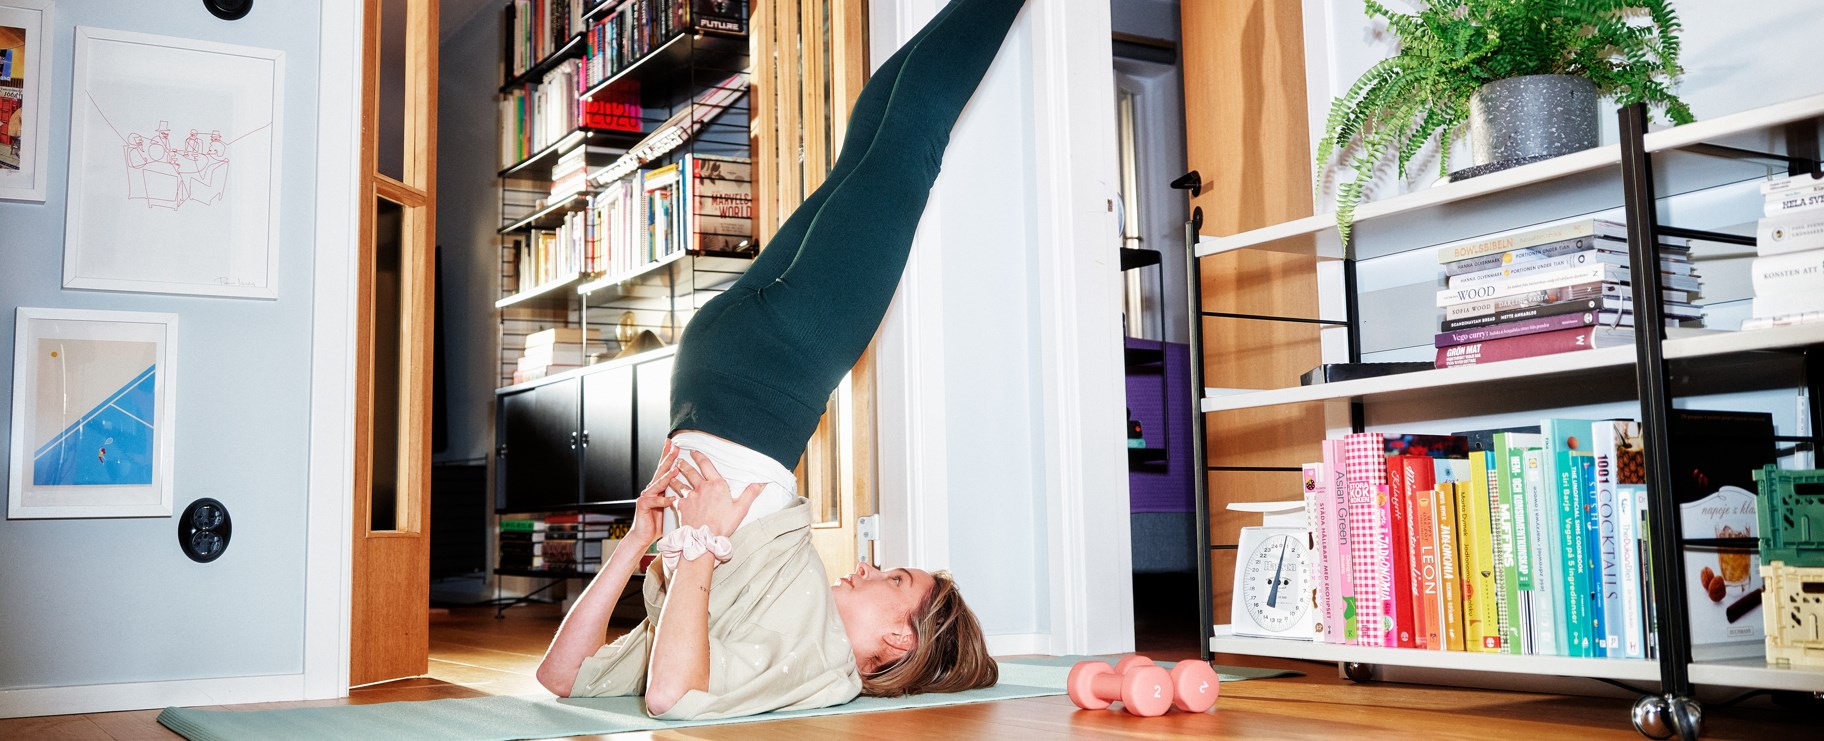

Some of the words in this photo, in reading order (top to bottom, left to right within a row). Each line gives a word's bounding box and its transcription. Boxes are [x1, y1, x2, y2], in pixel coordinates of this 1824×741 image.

[700, 19, 739, 30] FUTURE
[711, 193, 749, 206] MARVELS
[1782, 198, 1807, 210] HELA
[719, 205, 752, 219] WORLD
[1454, 238, 1513, 257] BOWLSBIBELN
[1457, 262, 1473, 270] HANNA
[1516, 250, 1541, 259] PORTIONEN
[1511, 266, 1536, 274] PORTIONEN
[1538, 262, 1552, 270] UNDER
[1764, 269, 1800, 279] KONSTEN
[1803, 266, 1817, 274] ATT
[1457, 285, 1496, 301] WOOD
[1452, 307, 1470, 315] SOFIA
[1472, 303, 1491, 312] WOOD
[1451, 319, 1481, 328] SCANDINAVIAN
[1452, 333, 1468, 343] Vego
[1447, 345, 1465, 358] GRÖN
[1466, 344, 1482, 354] MAT
[1598, 454, 1610, 484] 1001
[1335, 471, 1347, 505] Asian
[1405, 466, 1416, 497] Min
[1350, 489, 1369, 498] KOK
[1589, 481, 1598, 529] SUSHI
[1701, 502, 1730, 519] napoje
[1338, 508, 1348, 546] Green
[1499, 503, 1514, 568] MUFFINS
[1564, 517, 1573, 546] Vegan
[1566, 547, 1575, 559] på
[1600, 489, 1618, 600] COCKTAILS
[1464, 544, 1472, 583] Jadłonomia
[1536, 547, 1544, 577] zdrowiej
[1576, 536, 1584, 574] COOKBOOK
[1379, 535, 1391, 600] JADŁONOMIA
[1422, 545, 1436, 595] LEON
[1567, 568, 1578, 624] ingredienser
[1154, 685, 1161, 698] 2
[1200, 681, 1209, 694] 2
